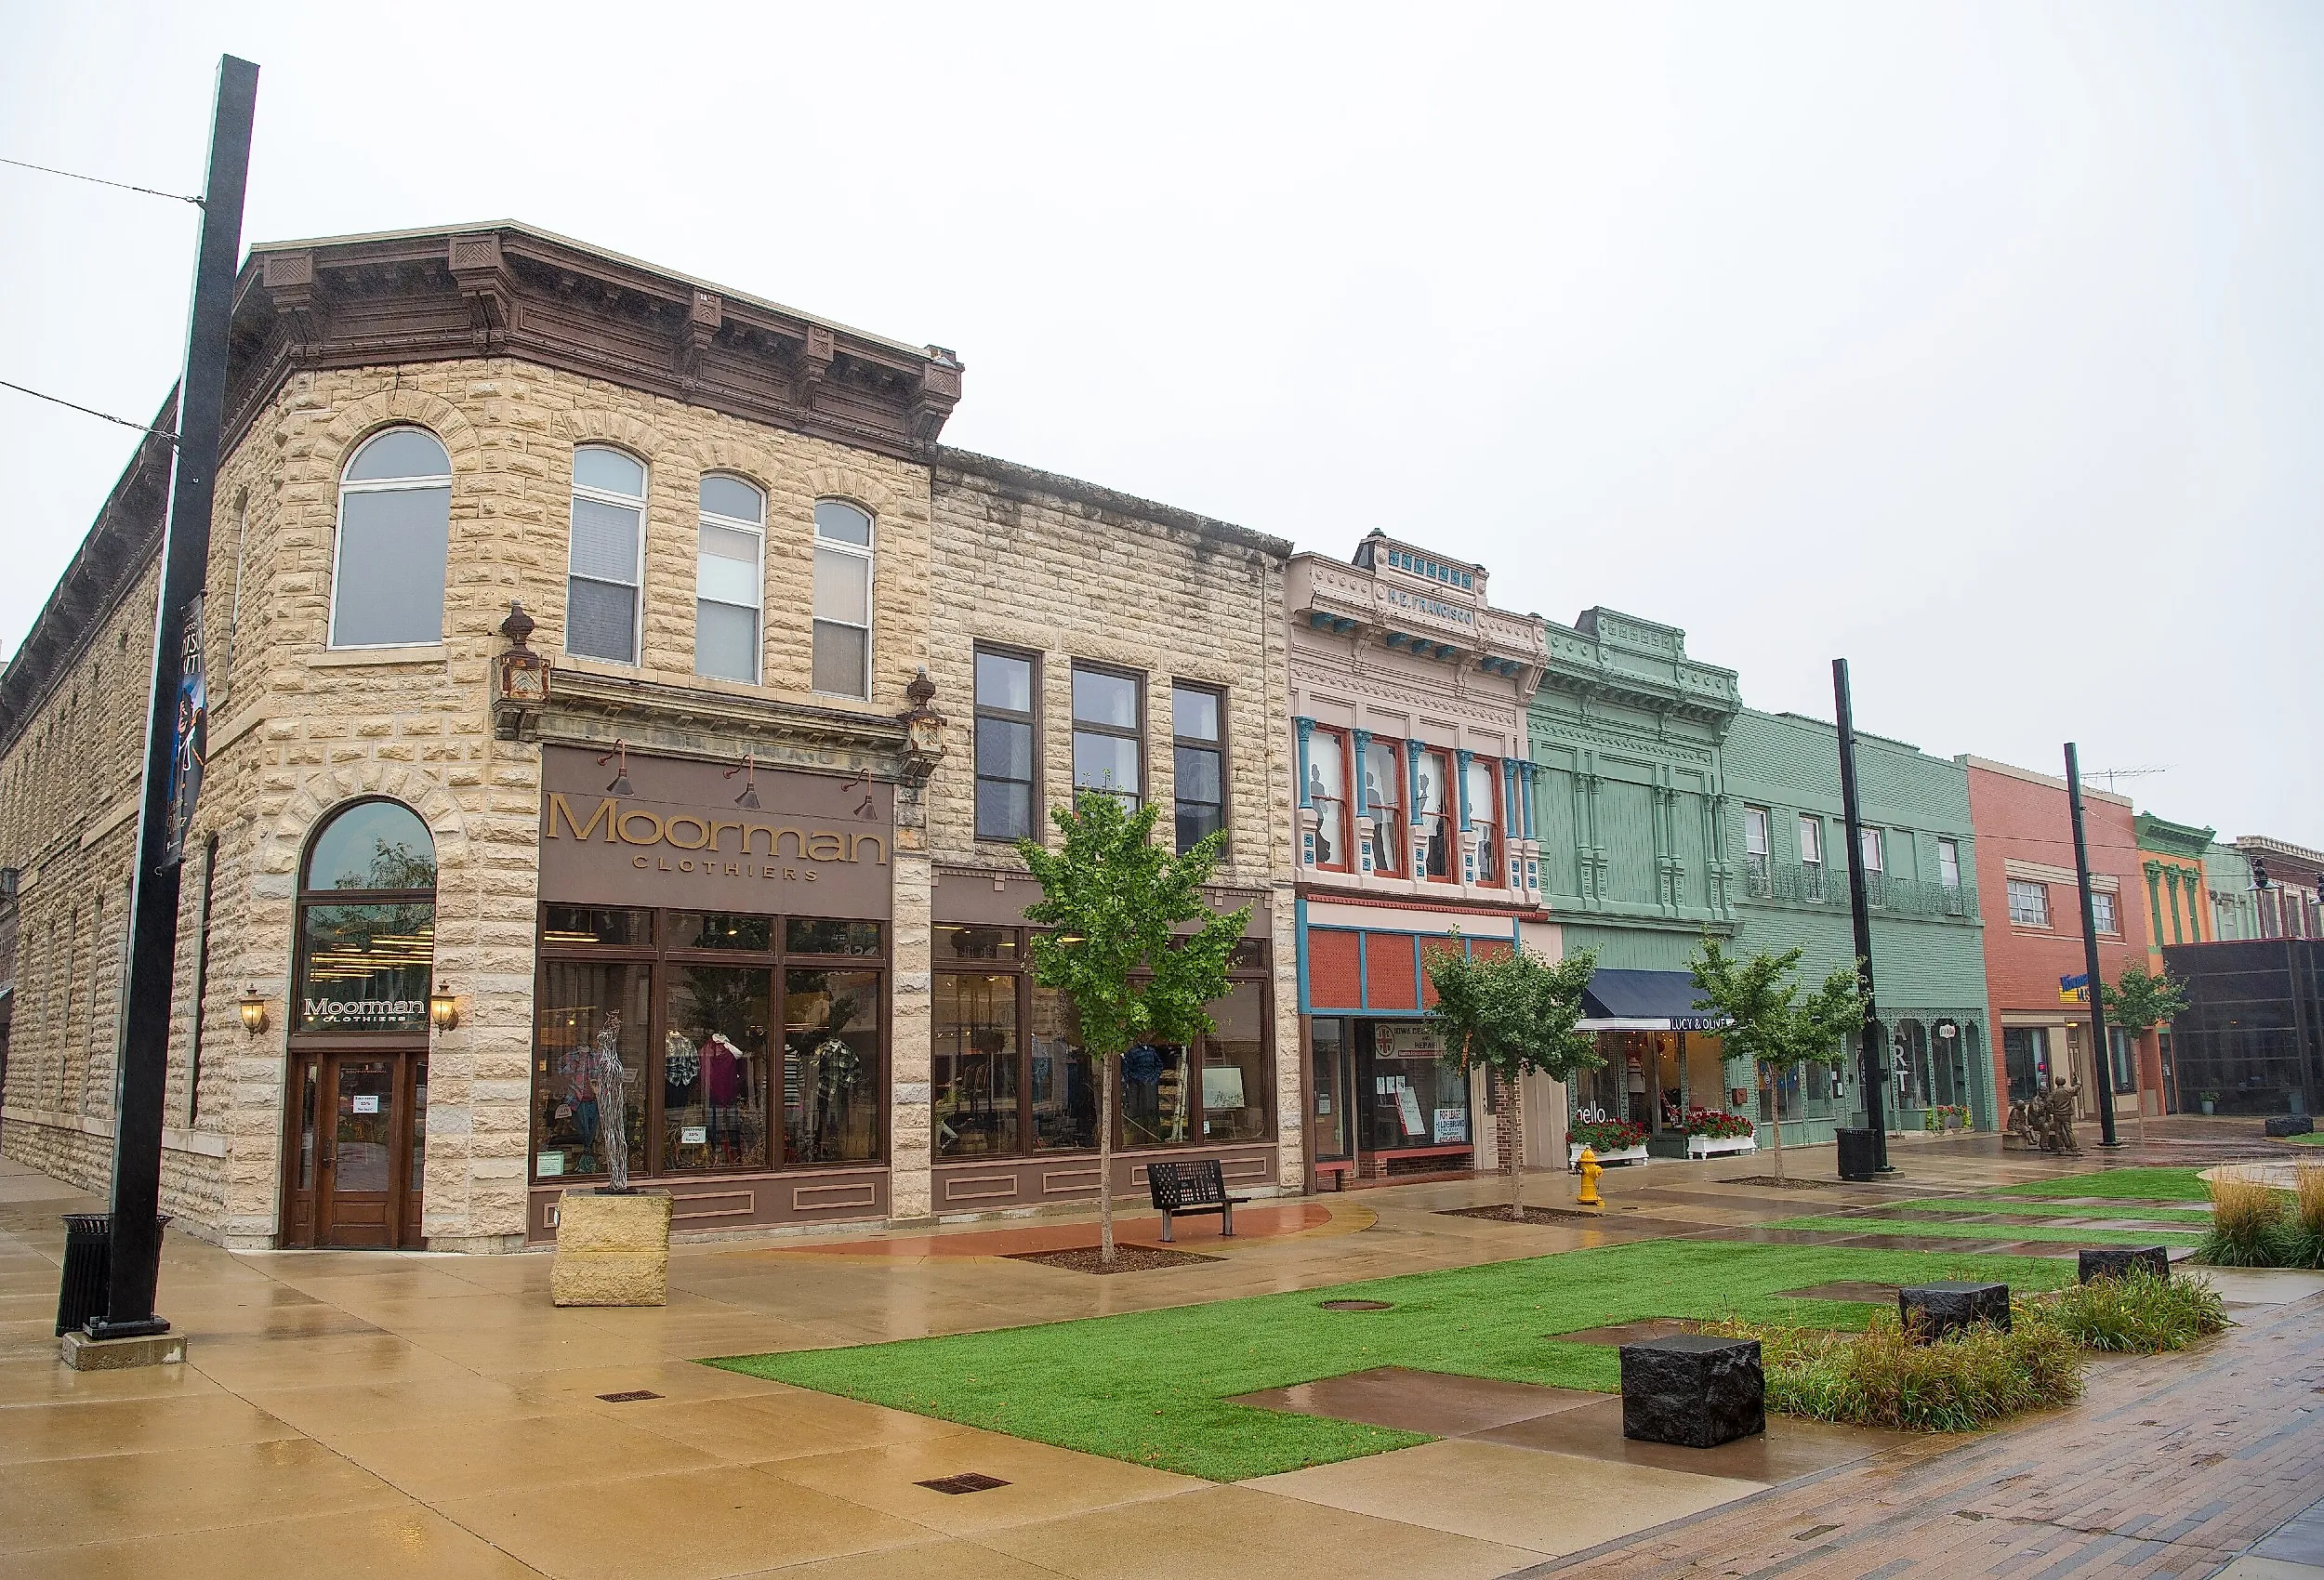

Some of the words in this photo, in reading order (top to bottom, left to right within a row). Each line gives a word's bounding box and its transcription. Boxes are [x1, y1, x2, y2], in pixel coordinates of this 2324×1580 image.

[546, 792, 888, 865] Moorman
[632, 854, 818, 882] CLOTHIERS
[303, 997, 426, 1015] Moorman
[1671, 1018, 1692, 1030] LUCY
[1695, 1018, 1701, 1030] &
